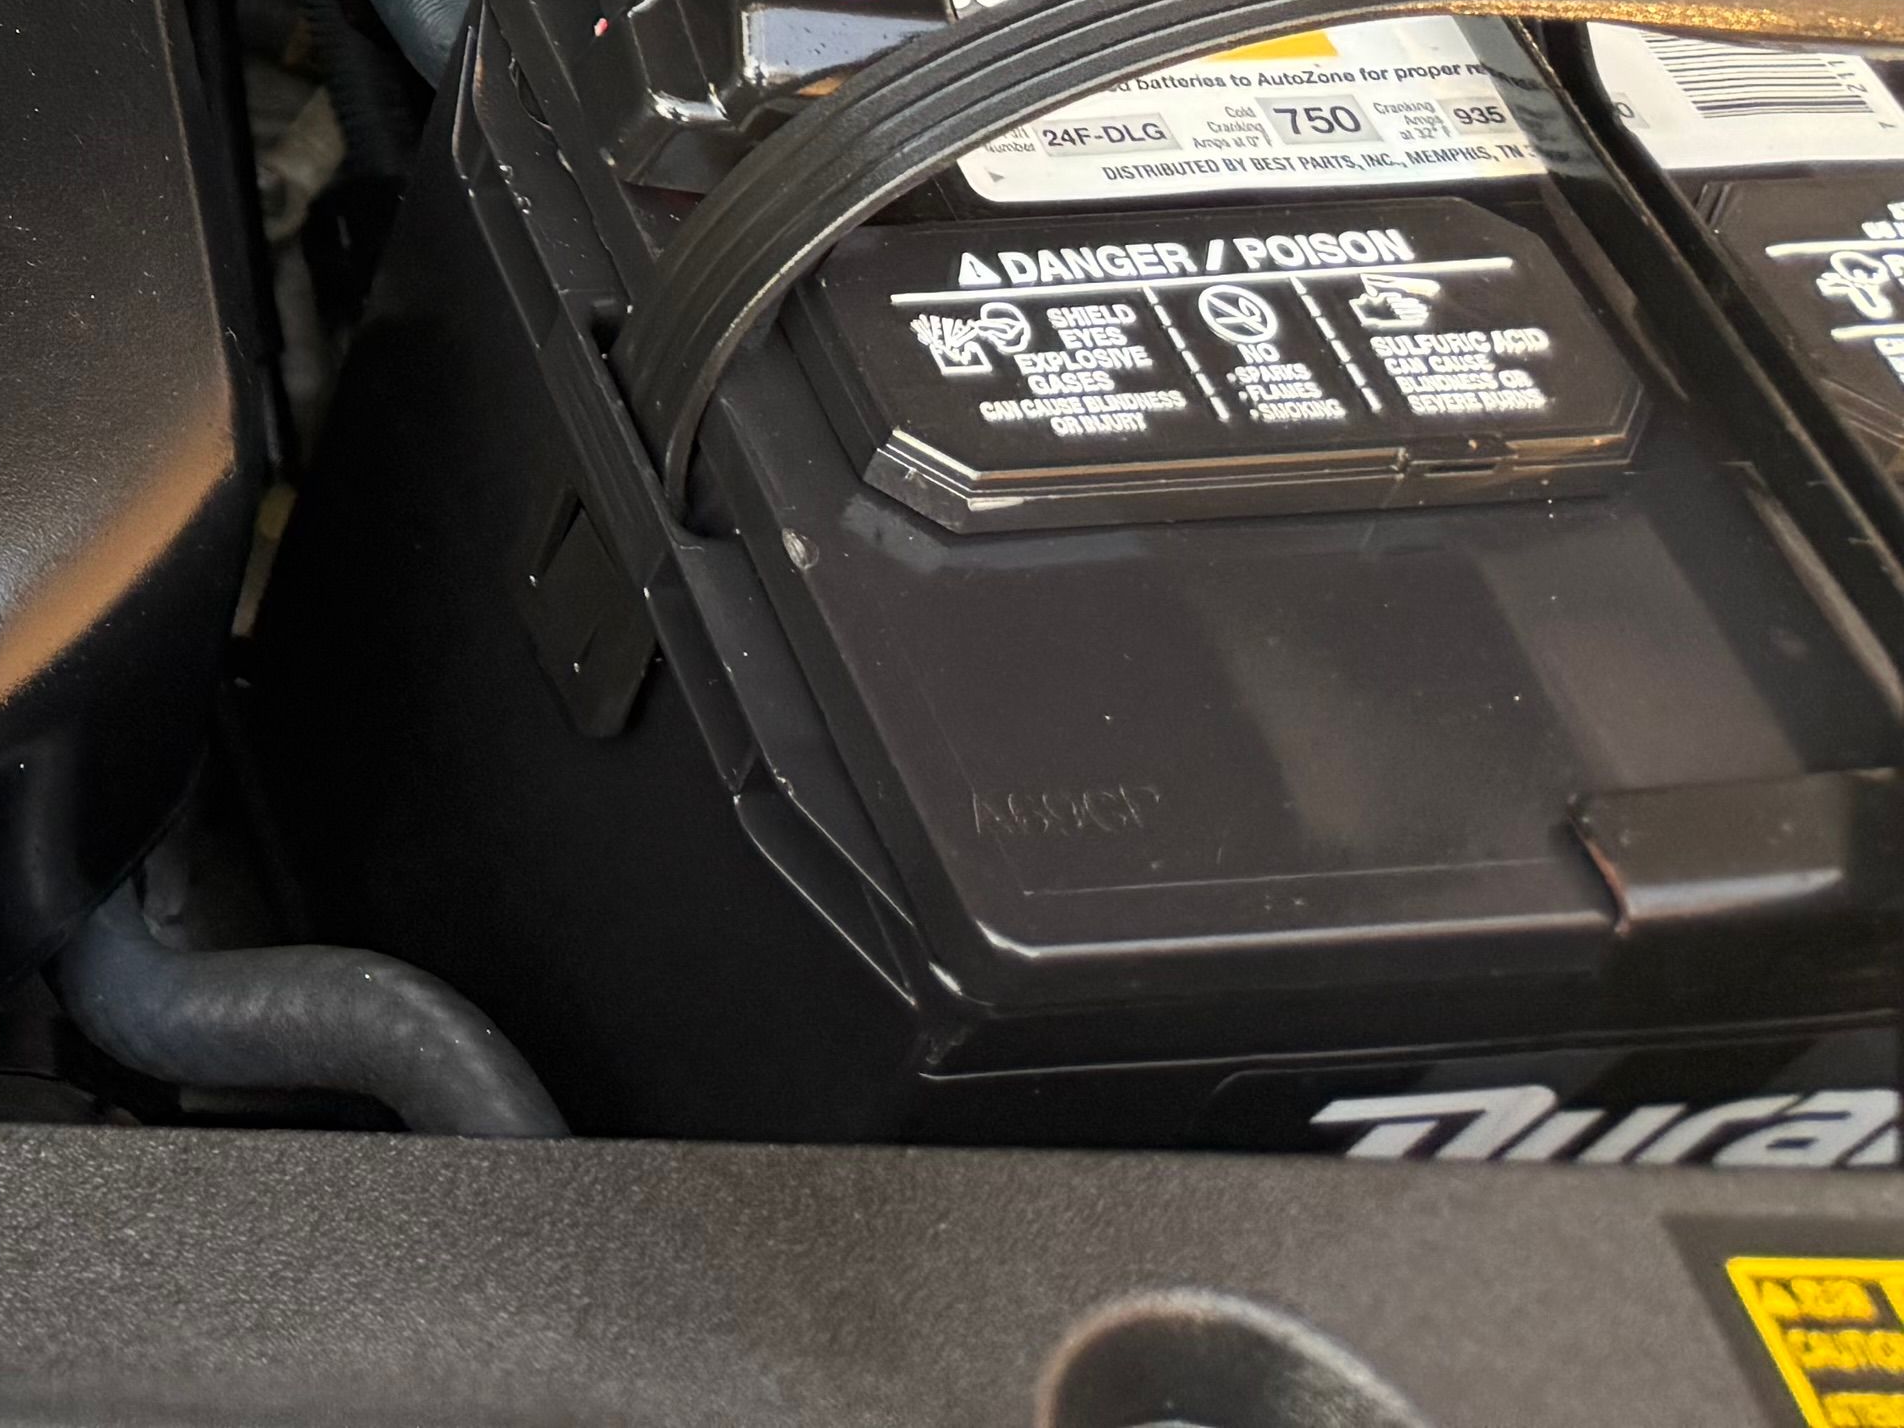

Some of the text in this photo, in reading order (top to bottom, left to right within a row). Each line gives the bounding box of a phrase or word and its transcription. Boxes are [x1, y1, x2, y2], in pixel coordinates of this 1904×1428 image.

[1136, 73, 1226, 91] batteries
[1231, 73, 1251, 88] to
[1258, 70, 1355, 87] AutoZone
[1359, 67, 1389, 82] for
[1396, 63, 1463, 82] proper
[1273, 105, 1362, 136] 750
[1453, 106, 1506, 126] 935
[1042, 122, 1167, 147] 24F-DLG
[1102, 159, 1219, 182] DISTRIBUTED
[1221, 157, 1249, 174] BY
[1251, 156, 1295, 173] BEST
[1299, 153, 1364, 172] PARTS,
[1405, 145, 1498, 166] MEMPHIS,
[1496, 143, 1524, 160] TN
[998, 242, 1197, 285] DANGER
[1233, 229, 1415, 269] POISON
[1046, 304, 1136, 328] SHIELD
[1058, 327, 1127, 349] EYES
[1370, 327, 1550, 359] SULFURIC ACID
[1014, 345, 1153, 375] EXPLOSIVE
[1237, 342, 1280, 364] NO
[1384, 353, 1496, 376] CAN CAUSE
[1027, 371, 1115, 395] GASES
[1395, 373, 1499, 395] BLINDNESS
[979, 390, 1187, 422] CAN CAUSE BLINDNESS
[1407, 391, 1481, 416] SEVERE
[1050, 412, 1147, 436] OR INJURY
[1310, 1085, 1900, 1167] Dura
